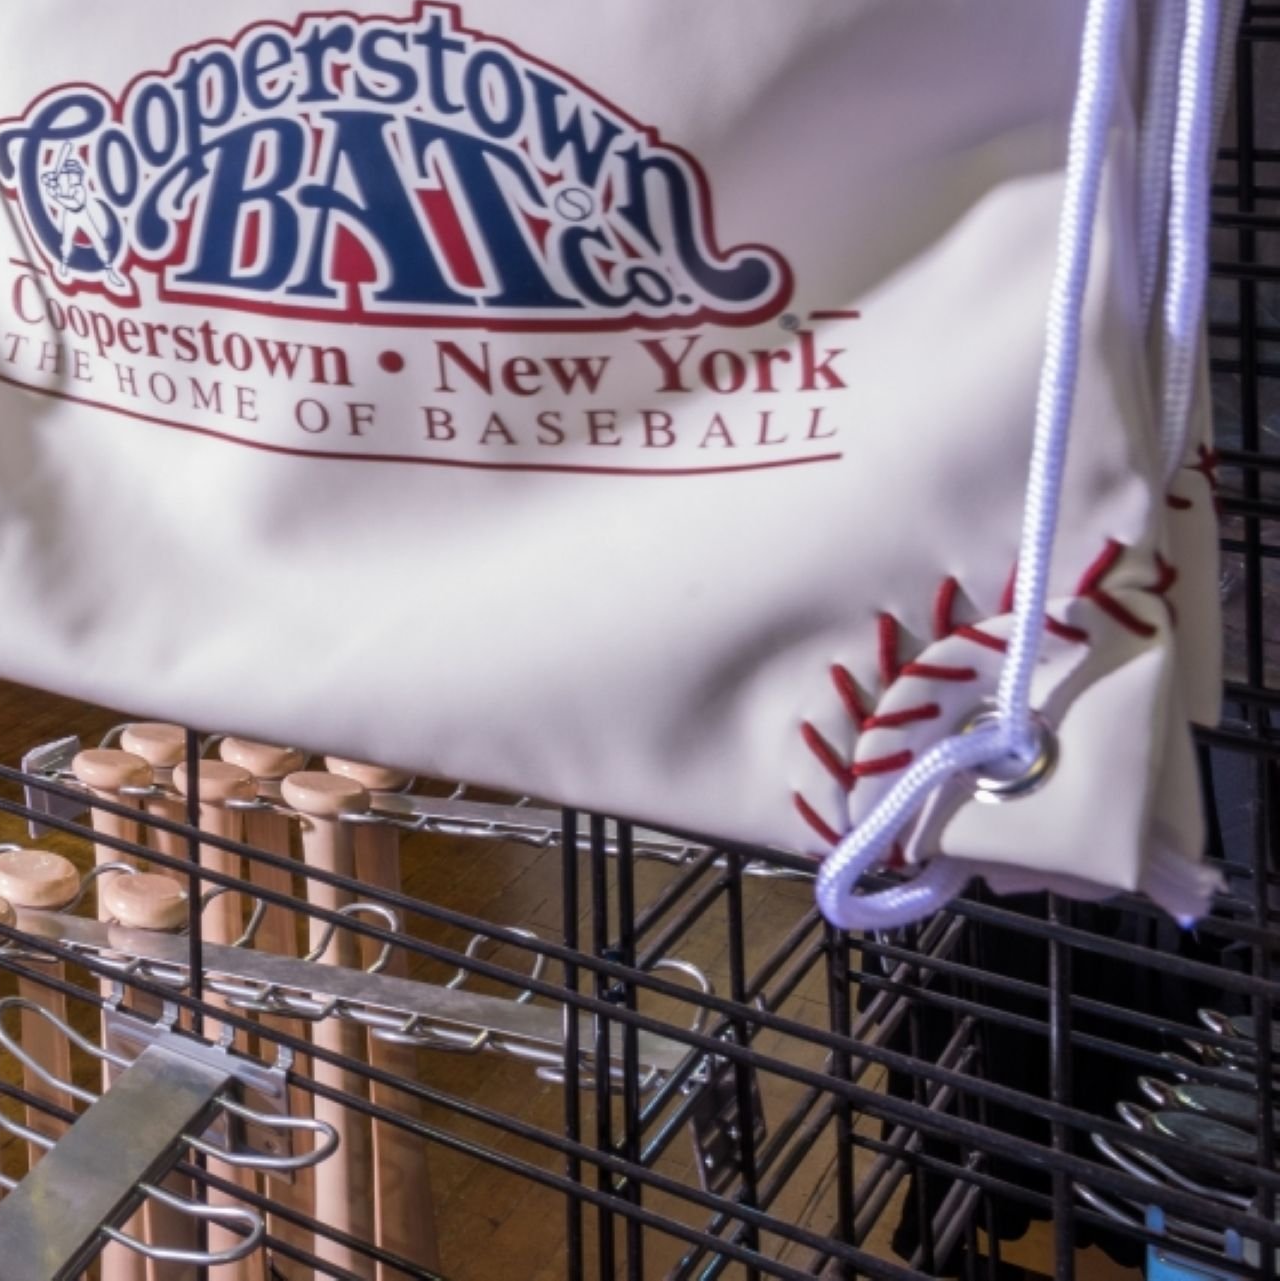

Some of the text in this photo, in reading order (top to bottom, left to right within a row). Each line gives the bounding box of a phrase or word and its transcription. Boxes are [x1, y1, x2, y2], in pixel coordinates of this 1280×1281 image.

[135, 109, 584, 308] BAT
[560, 225, 694, 309] Co.
[4, 332, 838, 450] THE HOME OF BASEBALL
[12, 273, 848, 397] Cooperstown New York
